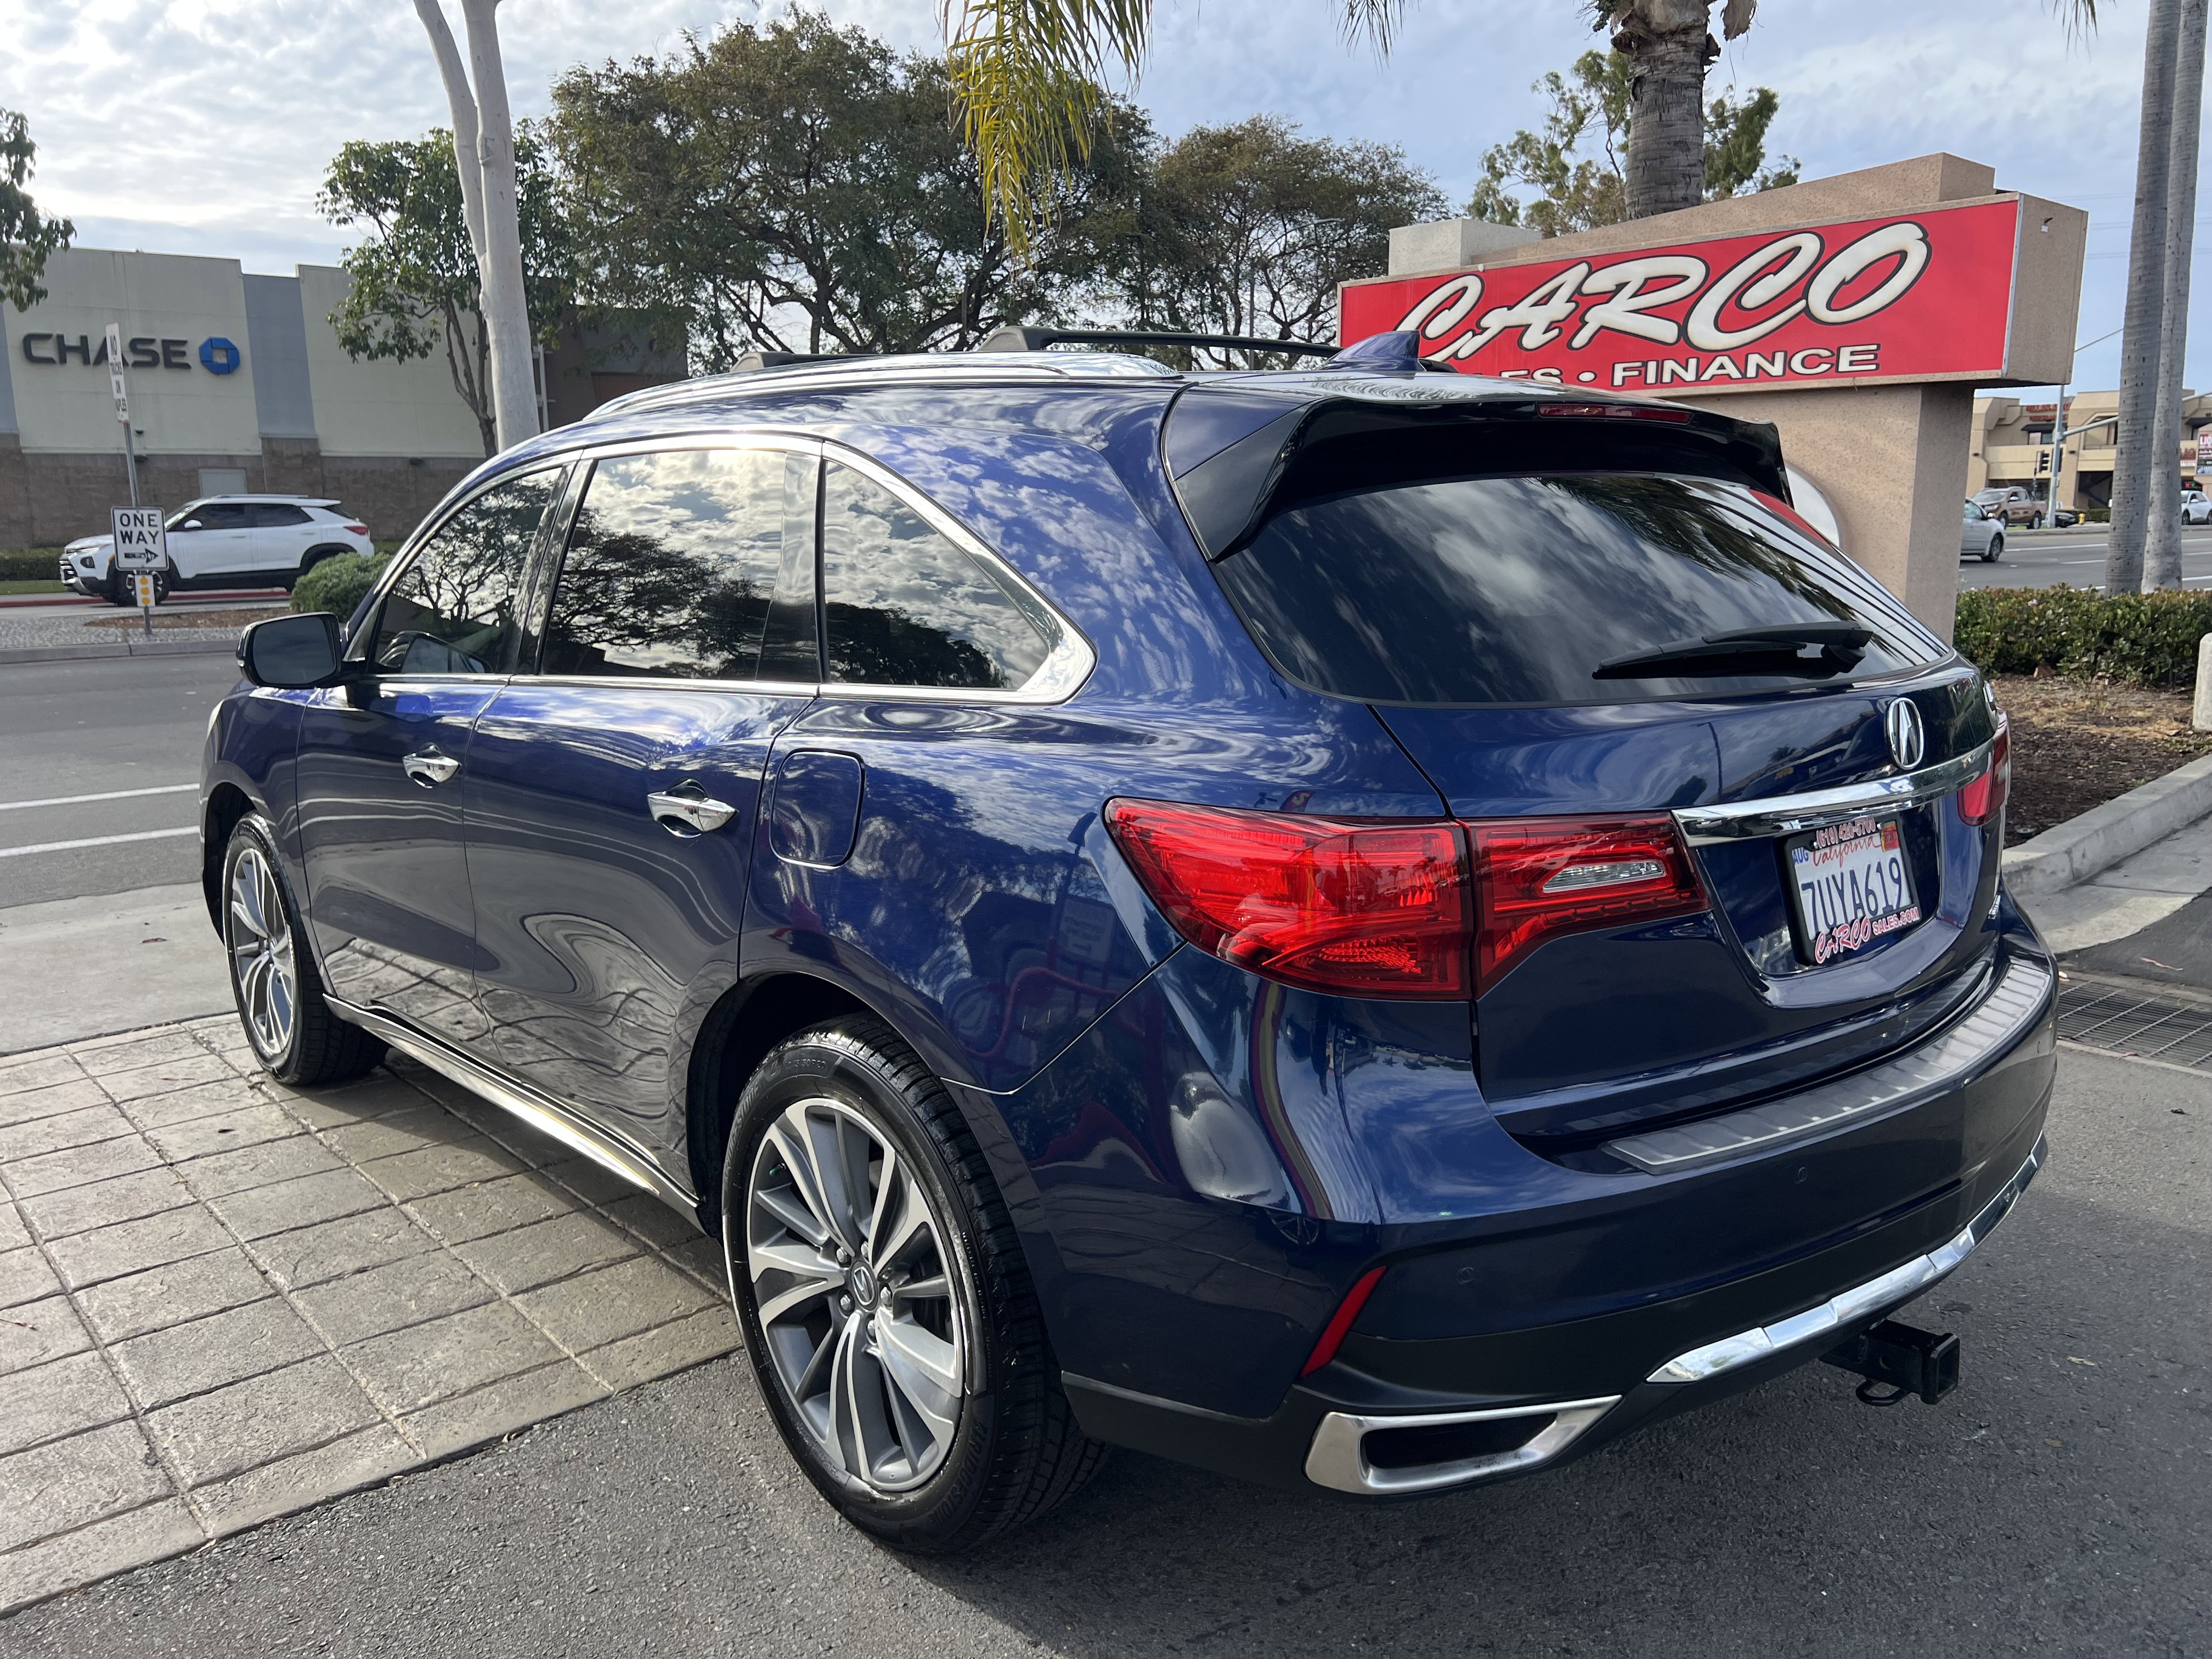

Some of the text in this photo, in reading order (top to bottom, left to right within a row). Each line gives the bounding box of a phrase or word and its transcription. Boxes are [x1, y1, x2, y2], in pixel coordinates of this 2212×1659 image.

[1395, 221, 1932, 363] CARCO
[22, 332, 191, 369] CHASE
[110, 335, 117, 356] NO
[1611, 343, 1881, 387] FINANCE
[120, 513, 158, 527] ONE
[120, 530, 159, 544] WAY
[1792, 848, 1809, 864] AUG
[1813, 836, 1881, 867] California
[1801, 857, 1902, 933] 7UYA619
[1872, 906, 1920, 935] SALES.COM
[1815, 916, 1871, 964] CARCO
